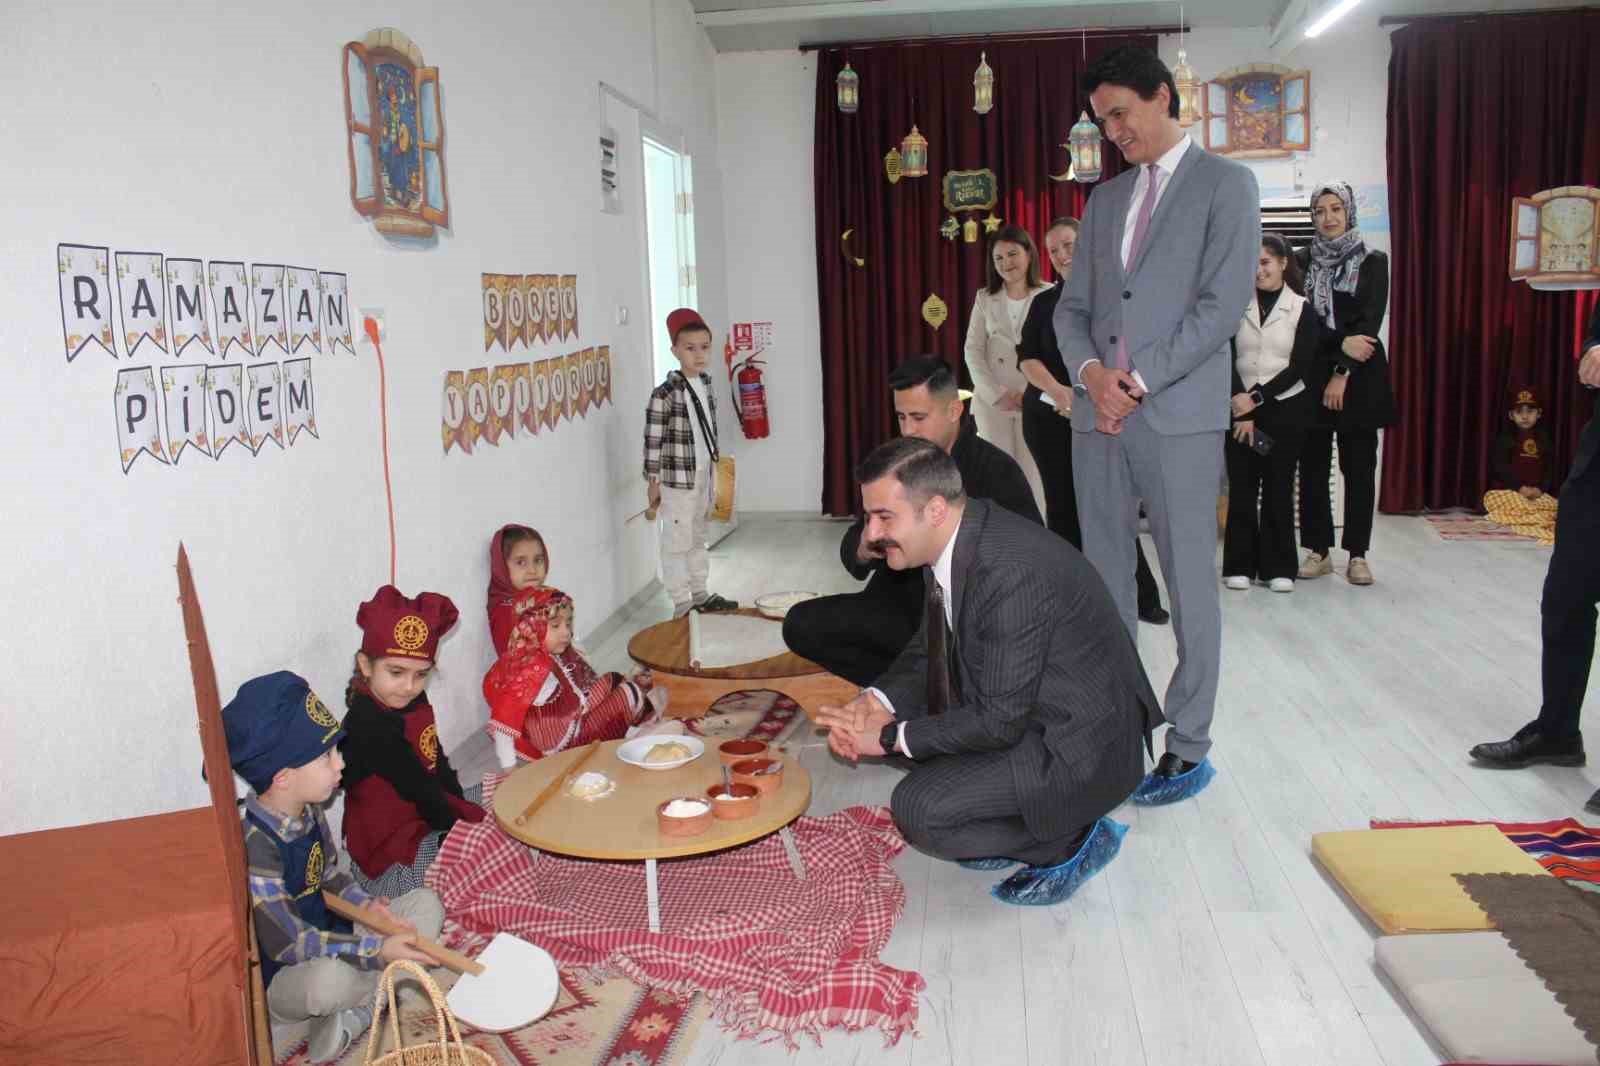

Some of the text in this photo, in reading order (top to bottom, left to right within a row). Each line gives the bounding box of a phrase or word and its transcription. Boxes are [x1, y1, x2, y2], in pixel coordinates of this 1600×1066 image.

[73, 275, 343, 326] RAMAZAN
[126, 379, 310, 433] PİDEM
[447, 359, 608, 421] YAPIYORUZ
